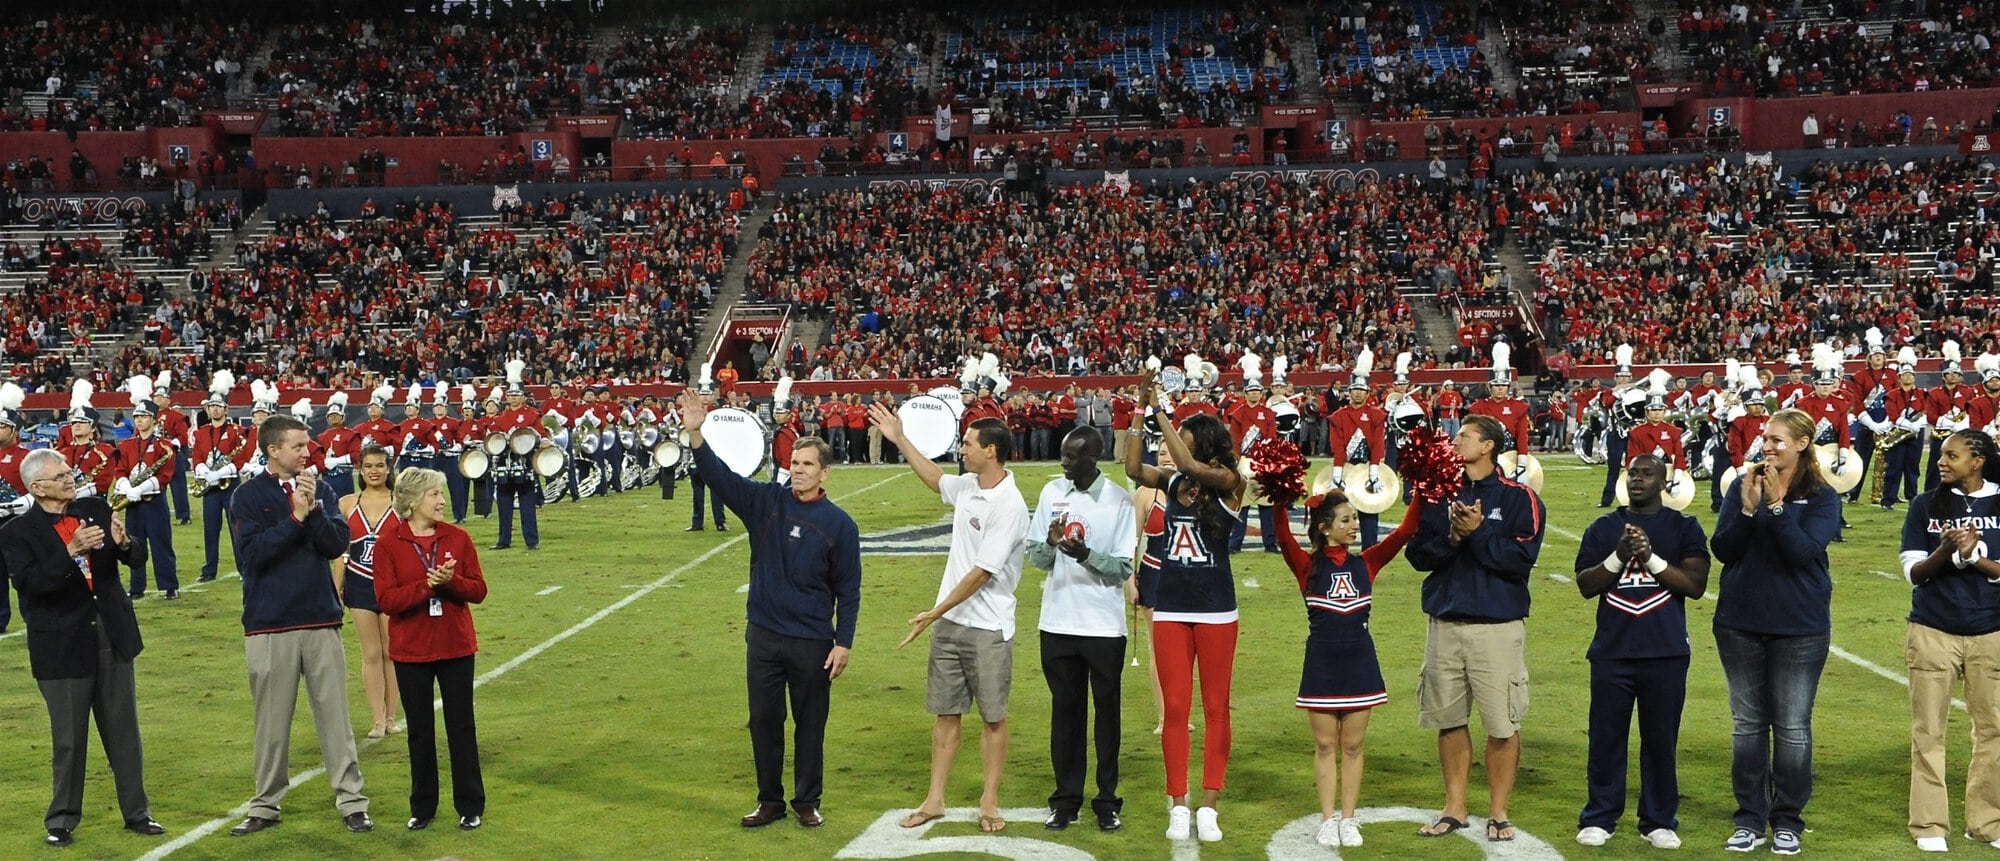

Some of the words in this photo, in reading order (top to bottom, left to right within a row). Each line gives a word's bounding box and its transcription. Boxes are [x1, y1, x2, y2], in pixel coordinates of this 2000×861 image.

[1713, 108, 1724, 121] 5
[1331, 122, 1341, 134] 4
[893, 135, 903, 147] 4
[537, 141, 547, 154] 3
[1474, 309, 1500, 319] SECTION
[1502, 309, 1507, 318] 5
[742, 327, 747, 335] 3
[748, 327, 773, 335] SECTION
[919, 403, 942, 411] YAMAHA
[720, 415, 745, 423] YAMAHA
[1927, 516, 2000, 533] AIZON
[1166, 516, 1214, 567] A
[1327, 572, 1359, 600] A
